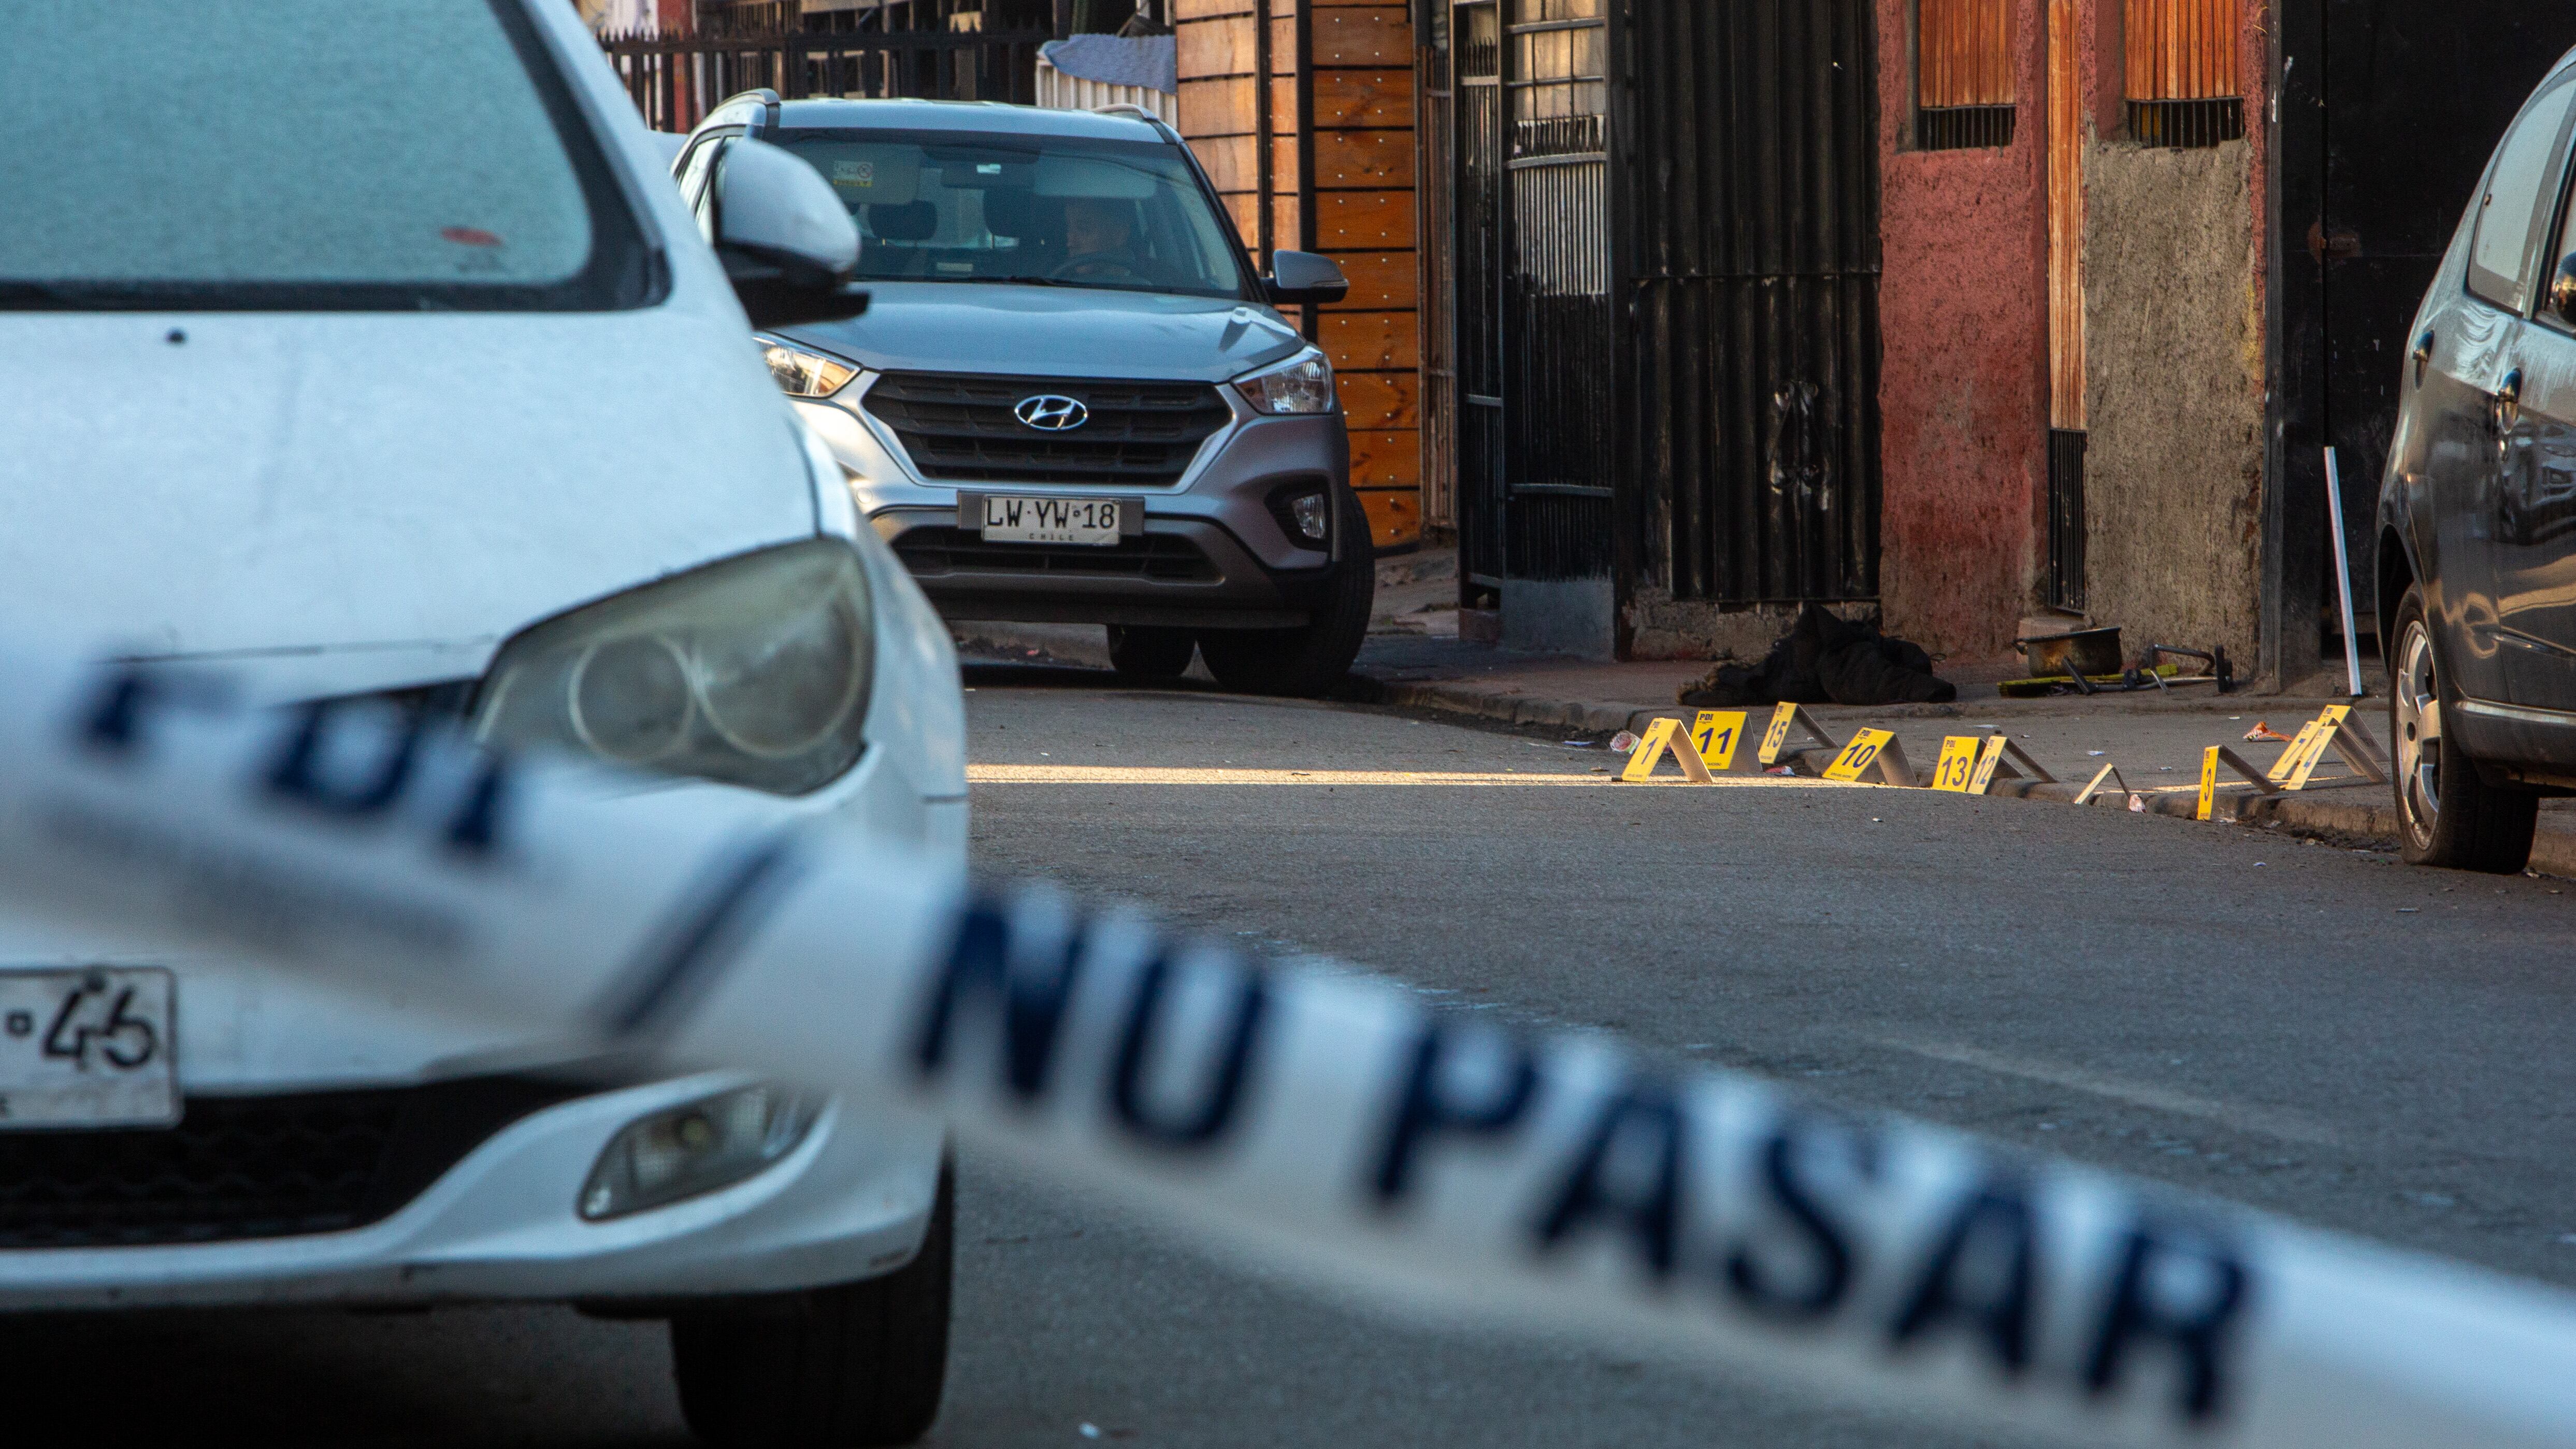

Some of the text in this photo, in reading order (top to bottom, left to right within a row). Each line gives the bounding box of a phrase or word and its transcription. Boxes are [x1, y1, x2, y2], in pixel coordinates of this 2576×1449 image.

[1029, 532, 1074, 541] CHILE
[1699, 727, 1733, 754] 11
[1766, 720, 1787, 748] 15
[1640, 736, 1659, 765] 1
[1841, 742, 1877, 768] 10
[1942, 755, 1968, 786] 13
[1975, 754, 1996, 785] 12
[2204, 768, 2211, 802] 3
[1368, 1015, 2251, 1427] PASAR
